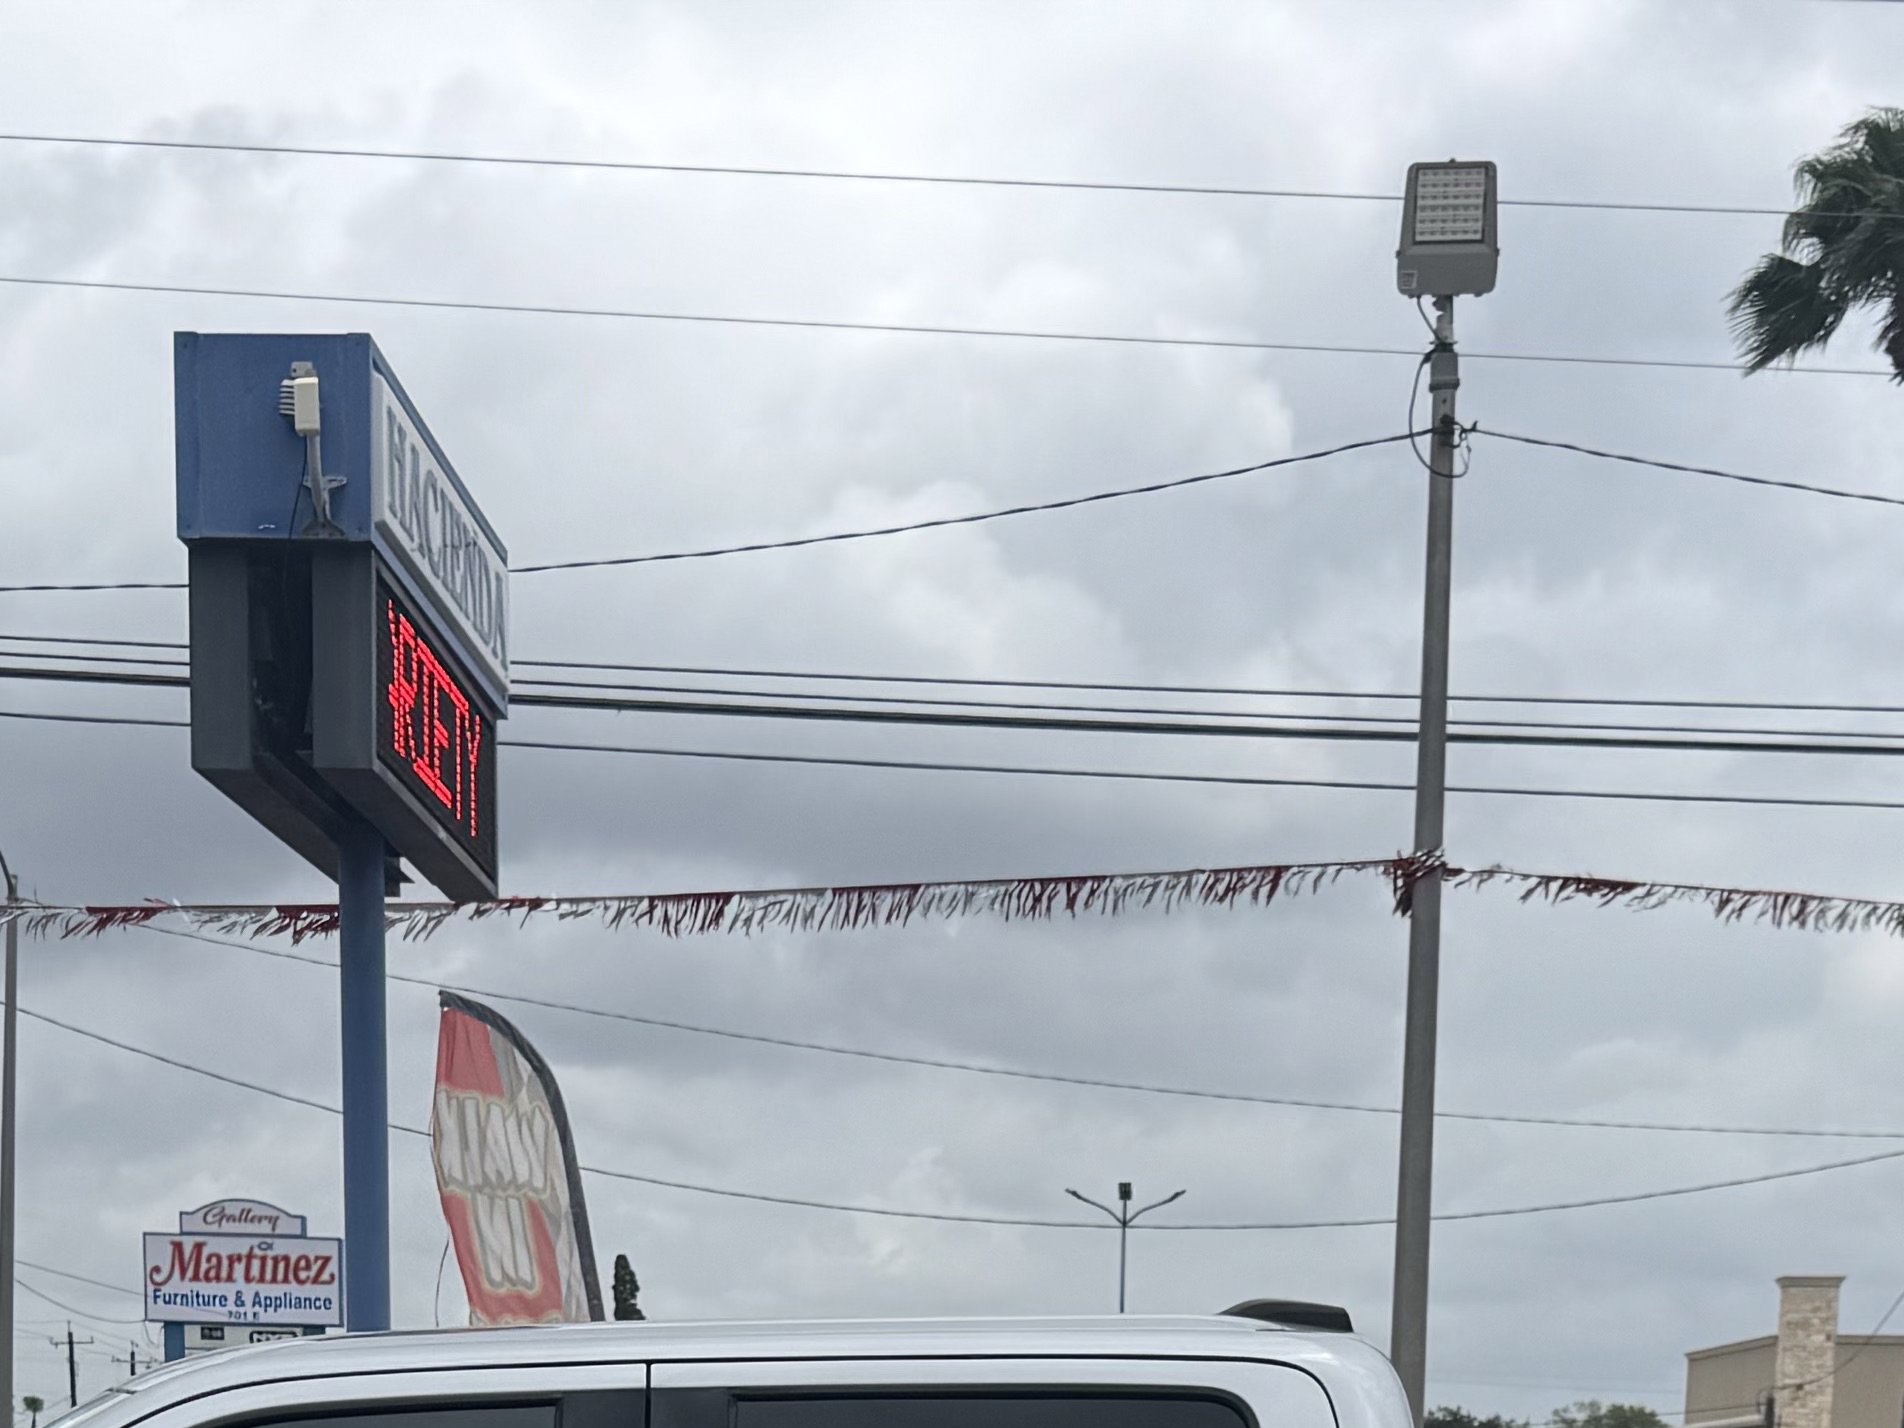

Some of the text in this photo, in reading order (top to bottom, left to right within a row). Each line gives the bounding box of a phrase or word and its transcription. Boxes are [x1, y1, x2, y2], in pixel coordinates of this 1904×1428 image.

[386, 404, 509, 672] HACIENDA
[202, 1204, 281, 1233] Gallery
[148, 1239, 336, 1287] Martinez
[152, 1288, 333, 1313] Furniture & Appliance
[227, 1310, 248, 1321] 701
